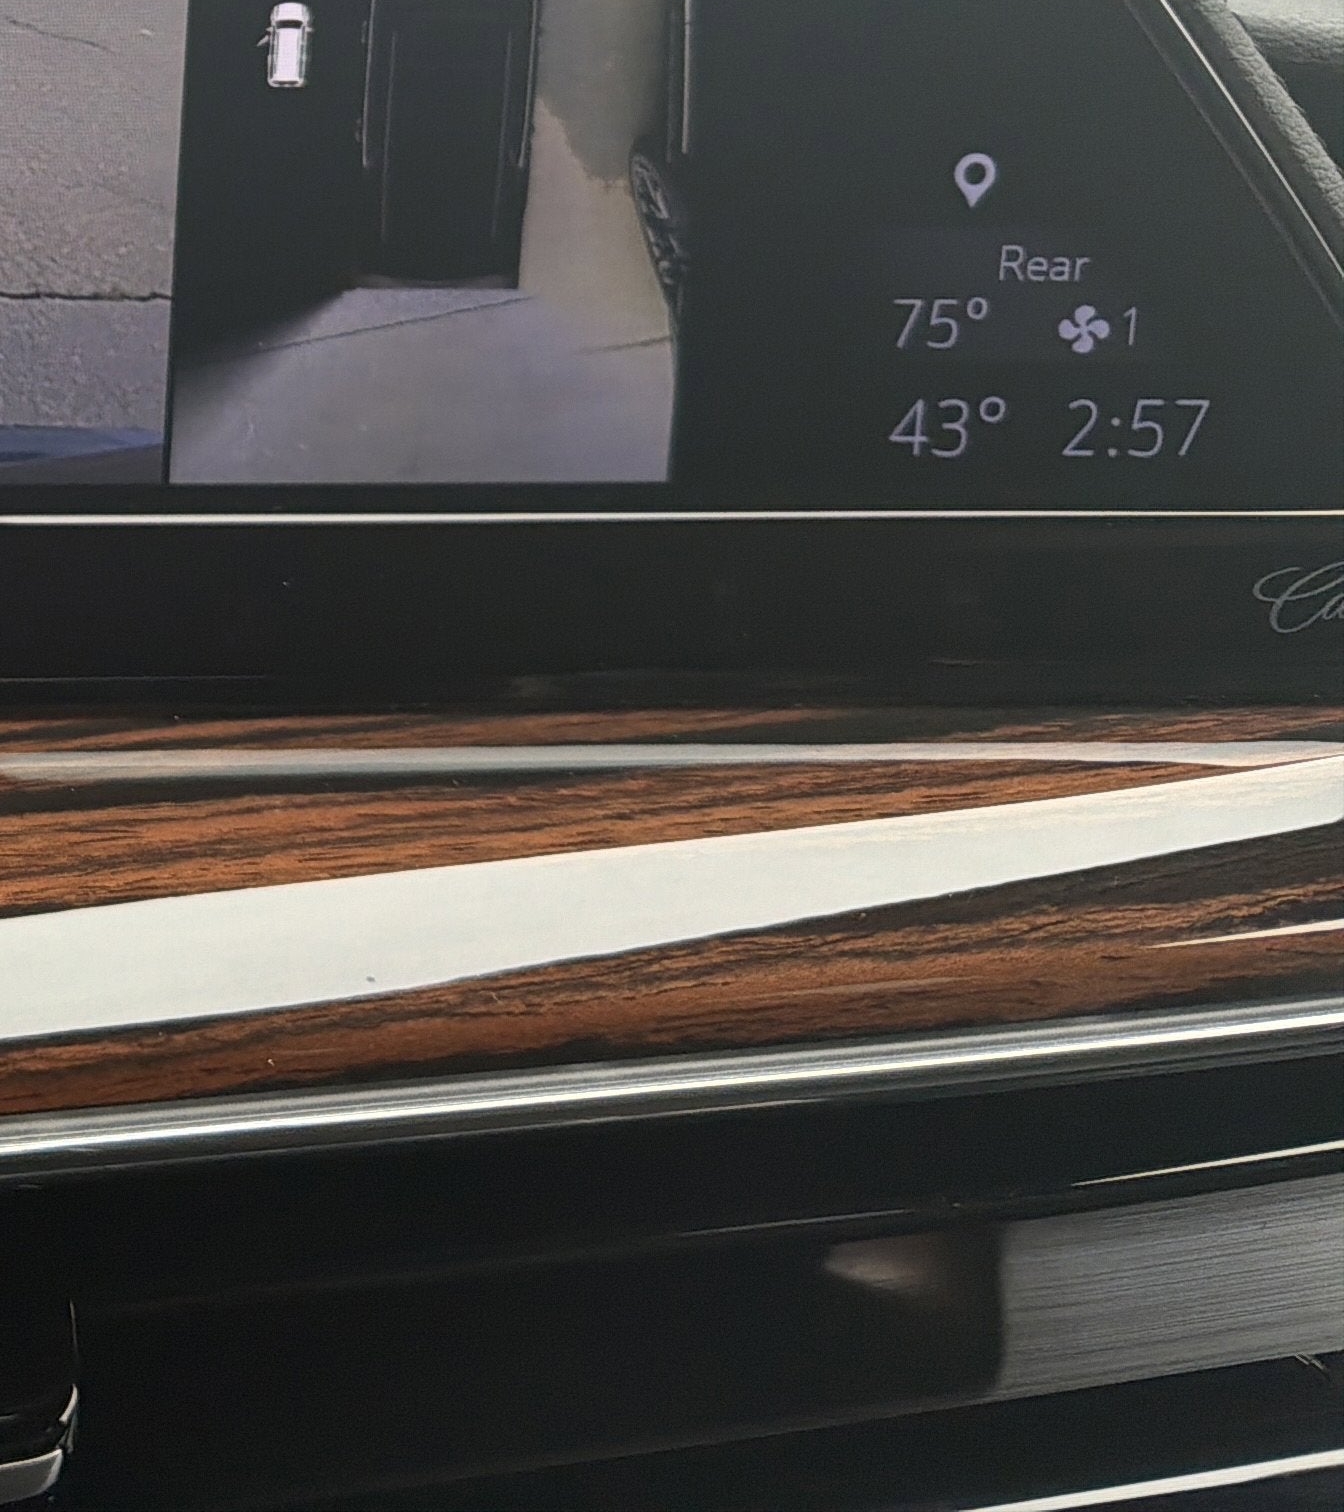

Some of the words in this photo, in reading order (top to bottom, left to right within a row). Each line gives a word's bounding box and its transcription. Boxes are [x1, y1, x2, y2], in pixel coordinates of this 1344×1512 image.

[998, 244, 1092, 283] Rear
[892, 296, 989, 350] 75°
[1122, 305, 1139, 347] 1
[887, 395, 1007, 459] 43°
[1061, 397, 1212, 459] 2:57
